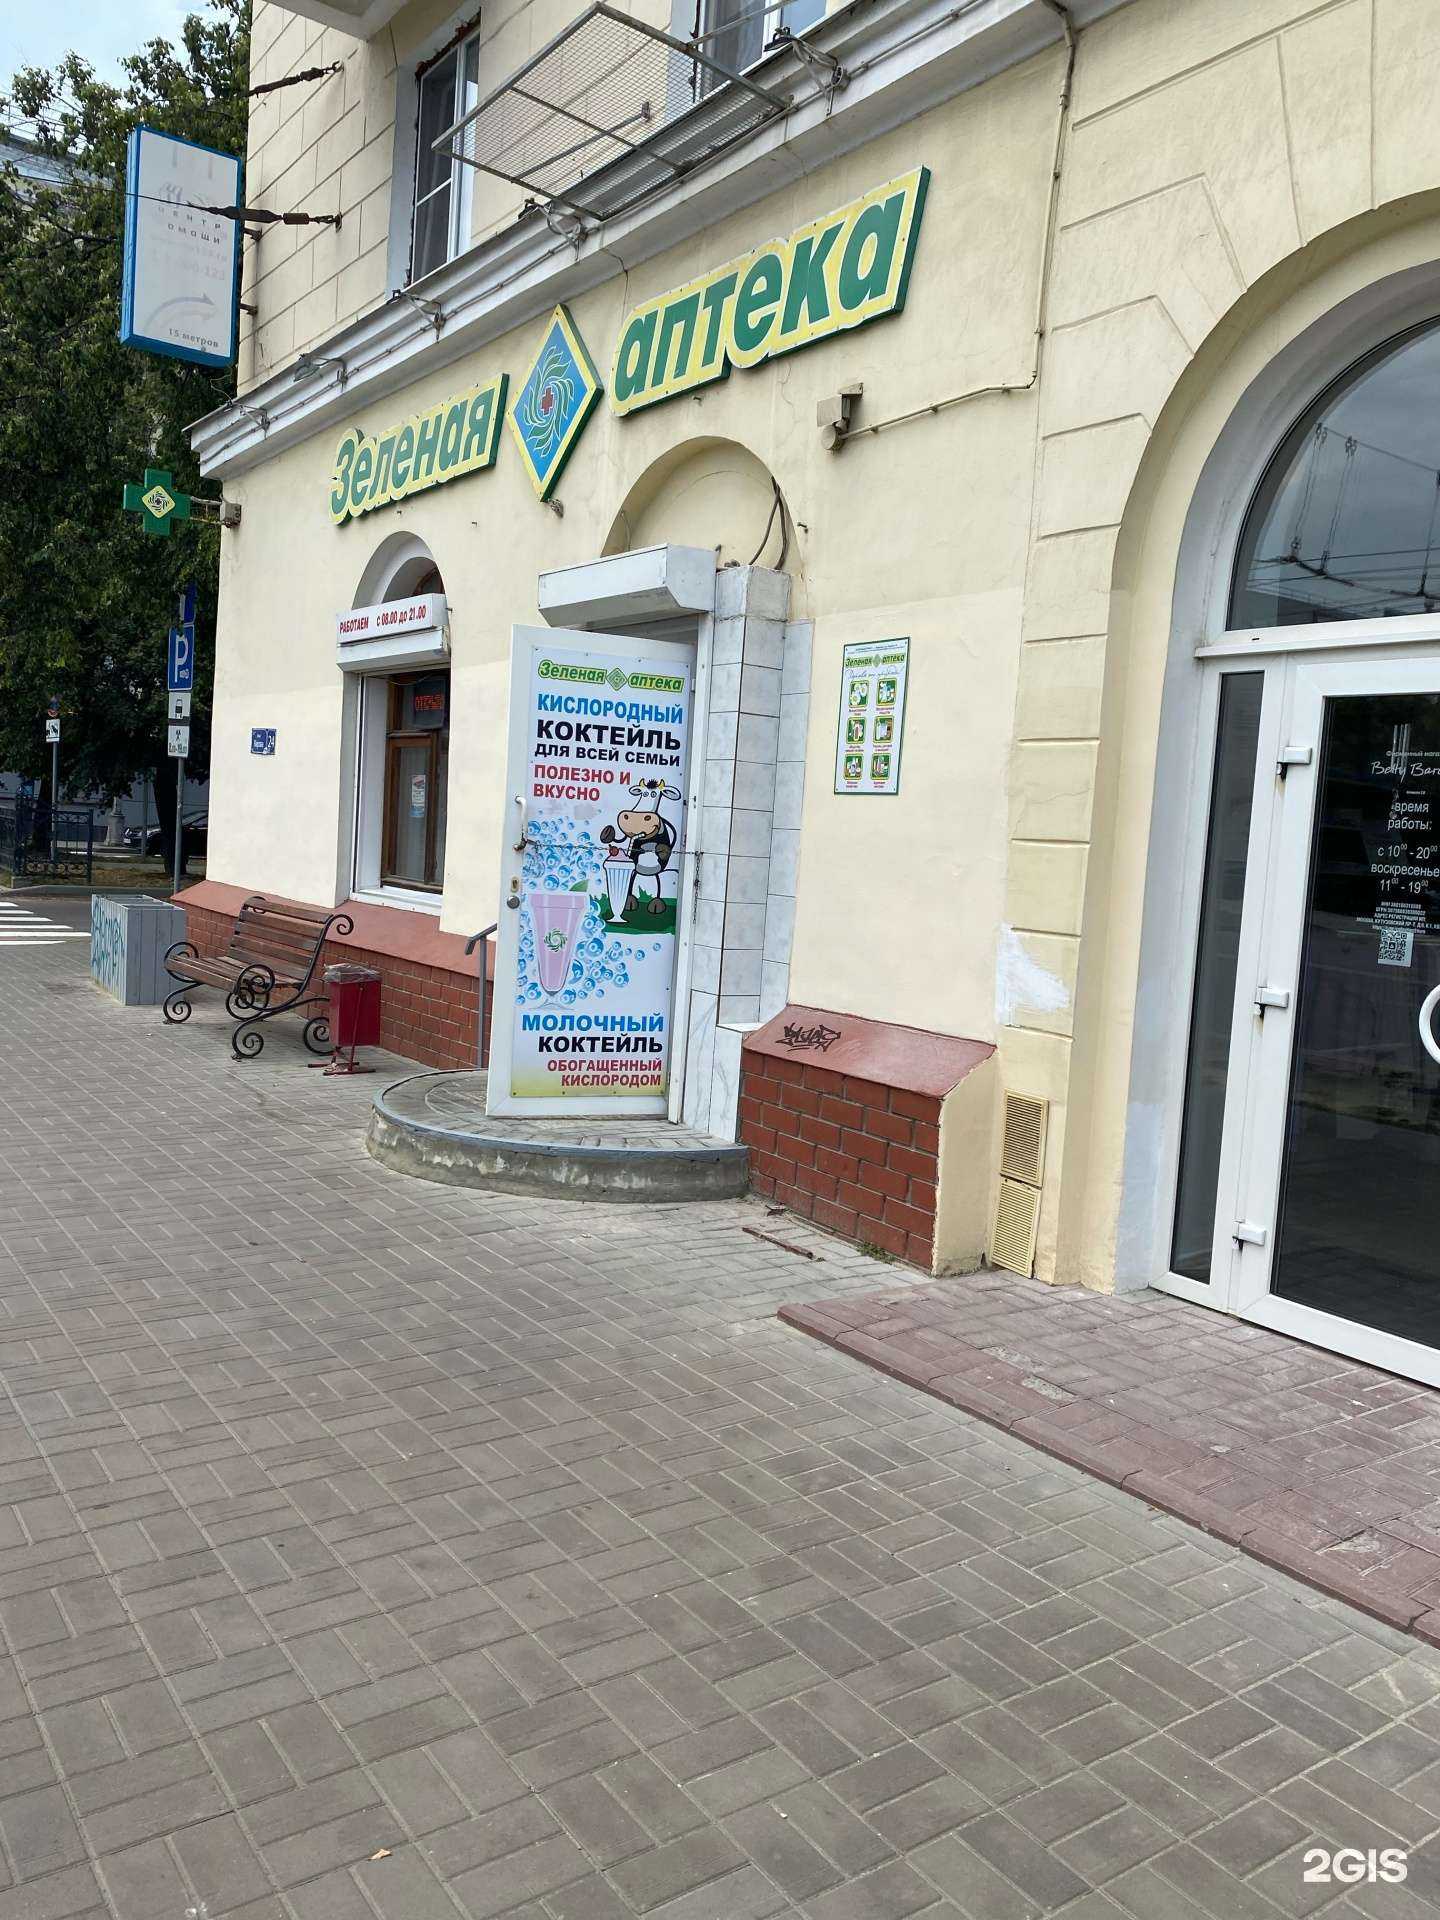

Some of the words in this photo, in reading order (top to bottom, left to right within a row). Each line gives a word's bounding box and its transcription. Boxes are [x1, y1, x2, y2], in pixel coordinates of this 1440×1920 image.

[331, 390, 495, 517] Зеленая
[615, 190, 906, 402] аптека
[340, 616, 369, 634] РАБОТАЕМ
[539, 660, 605, 684] Зеленая
[629, 673, 683, 691] аптека
[538, 693, 683, 725] КИСЛОРОДНЫЙ
[537, 719, 681, 750] КОКТЕЙЛЬ
[535, 743, 570, 758] ДЛЯ
[576, 746, 619, 762] ВСЕЙ
[625, 751, 681, 767] СЕМЬИ
[534, 765, 615, 784] ПОЛЕЗНО
[620, 772, 631, 785] И
[533, 783, 600, 801] ВКУСНО
[1394, 802, 1429, 815] время
[1387, 816, 1432, 831] работы:
[1371, 863, 1440, 877] воскресенье
[522, 1012, 664, 1032] МОЛОЧНЫЙ
[538, 1033, 663, 1053] КОКТЕЙЛЬ
[547, 1058, 662, 1074] ОБОГАЩЕННЫЙ
[561, 1074, 661, 1088] КИСЛОРОДОМ
